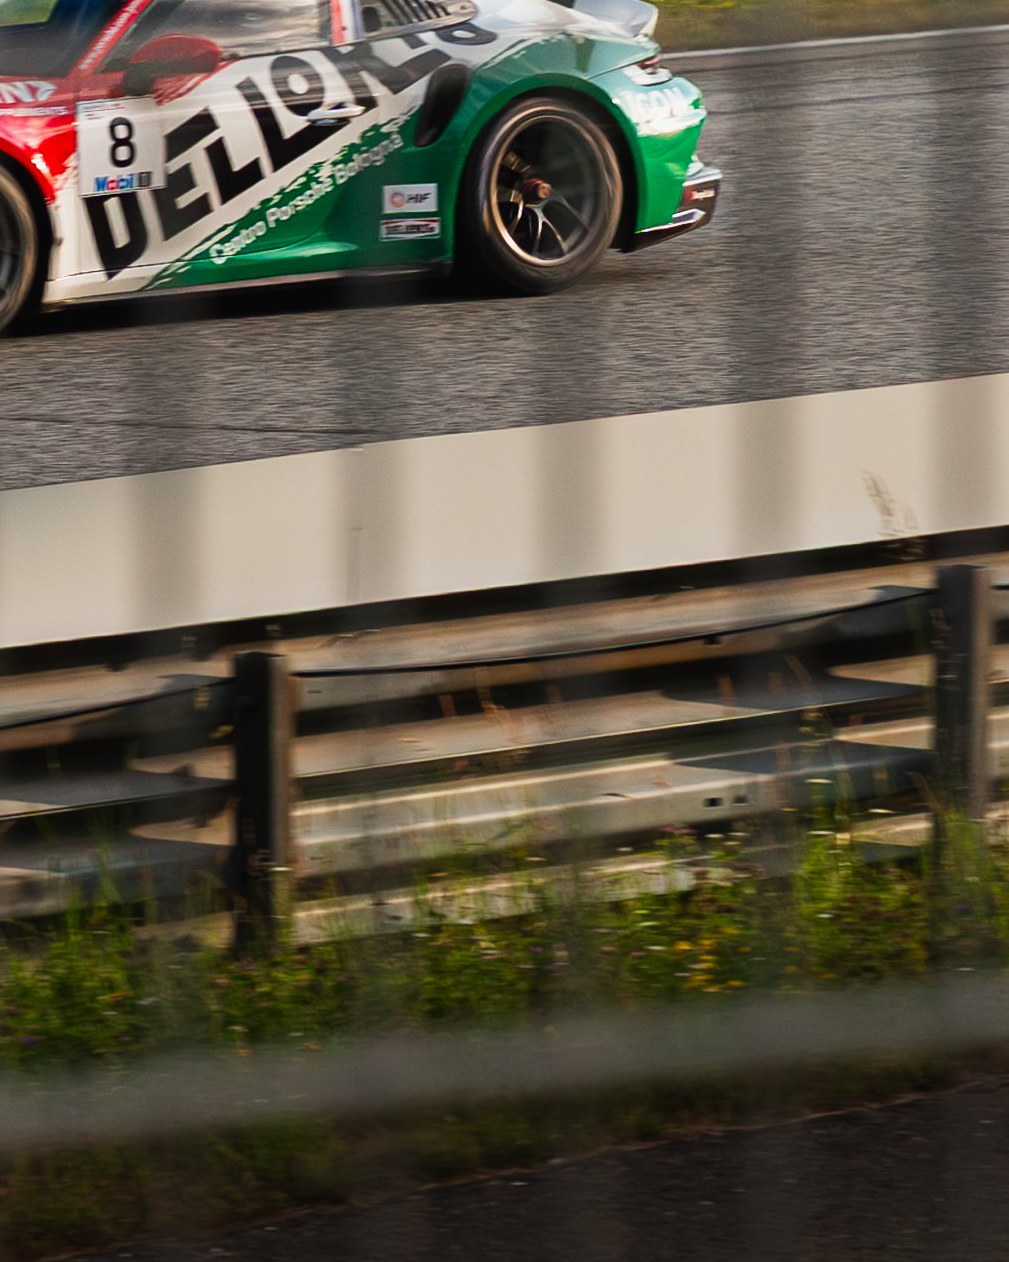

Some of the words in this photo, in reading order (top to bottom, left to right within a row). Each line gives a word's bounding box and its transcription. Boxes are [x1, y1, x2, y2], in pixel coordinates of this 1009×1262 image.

[109, 117, 136, 168] 8
[94, 173, 135, 192] Mobil
[209, 220, 267, 264] Centro
[266, 178, 335, 227] Porsche
[333, 134, 404, 185] Bologna
